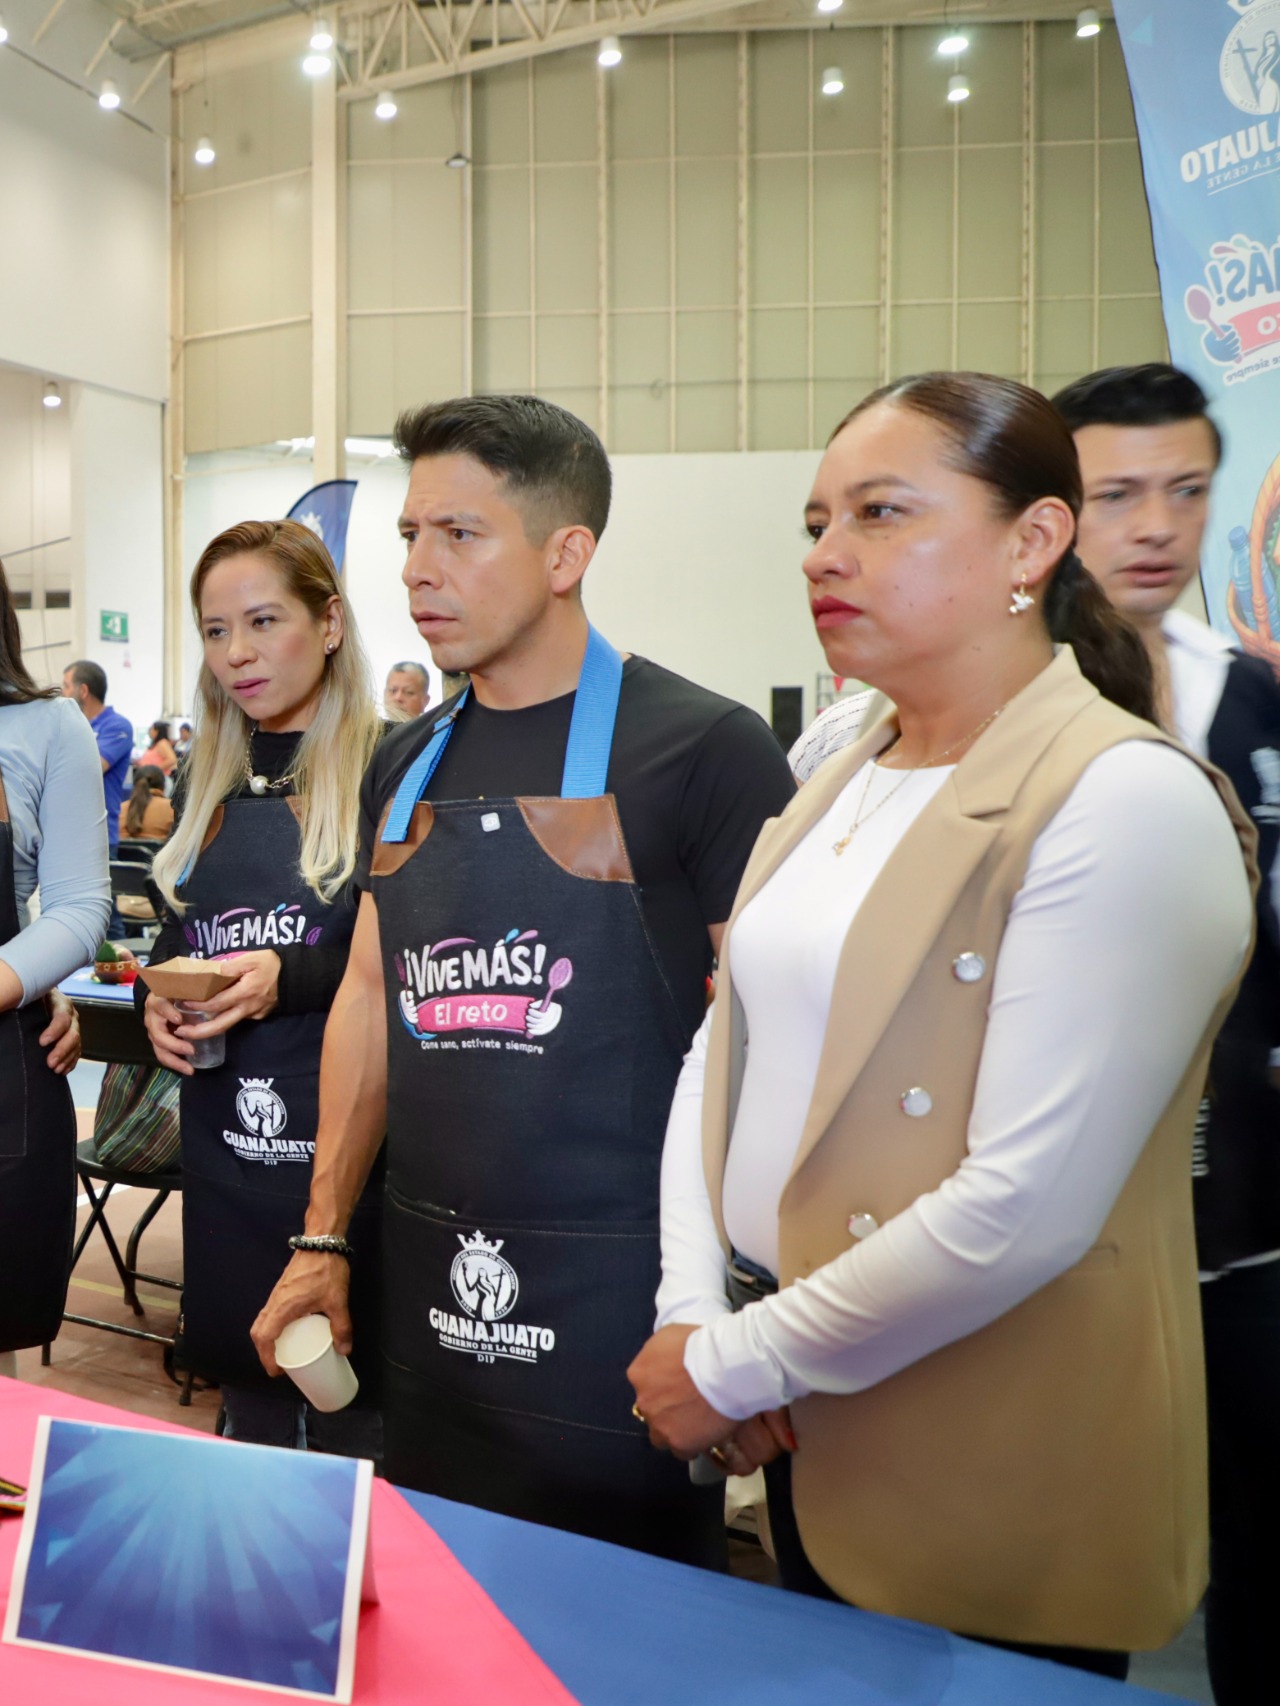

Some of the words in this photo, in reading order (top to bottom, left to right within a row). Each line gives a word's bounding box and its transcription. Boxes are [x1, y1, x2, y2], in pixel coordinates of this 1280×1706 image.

[435, 1003, 451, 1026] El
[456, 1000, 508, 1024] reto
[421, 1040, 439, 1050] Come
[505, 1041, 544, 1055] siempre
[222, 1129, 316, 1154] GUANAJUATO
[234, 1147, 264, 1158] GOBIERNO
[429, 1307, 555, 1351] GUANAJUATO
[438, 1333, 479, 1350] GOBIERNO
[481, 1342, 493, 1351] DE
[496, 1343, 508, 1353] LA
[509, 1345, 538, 1359] GENTE
[477, 1354, 496, 1364] DIF
